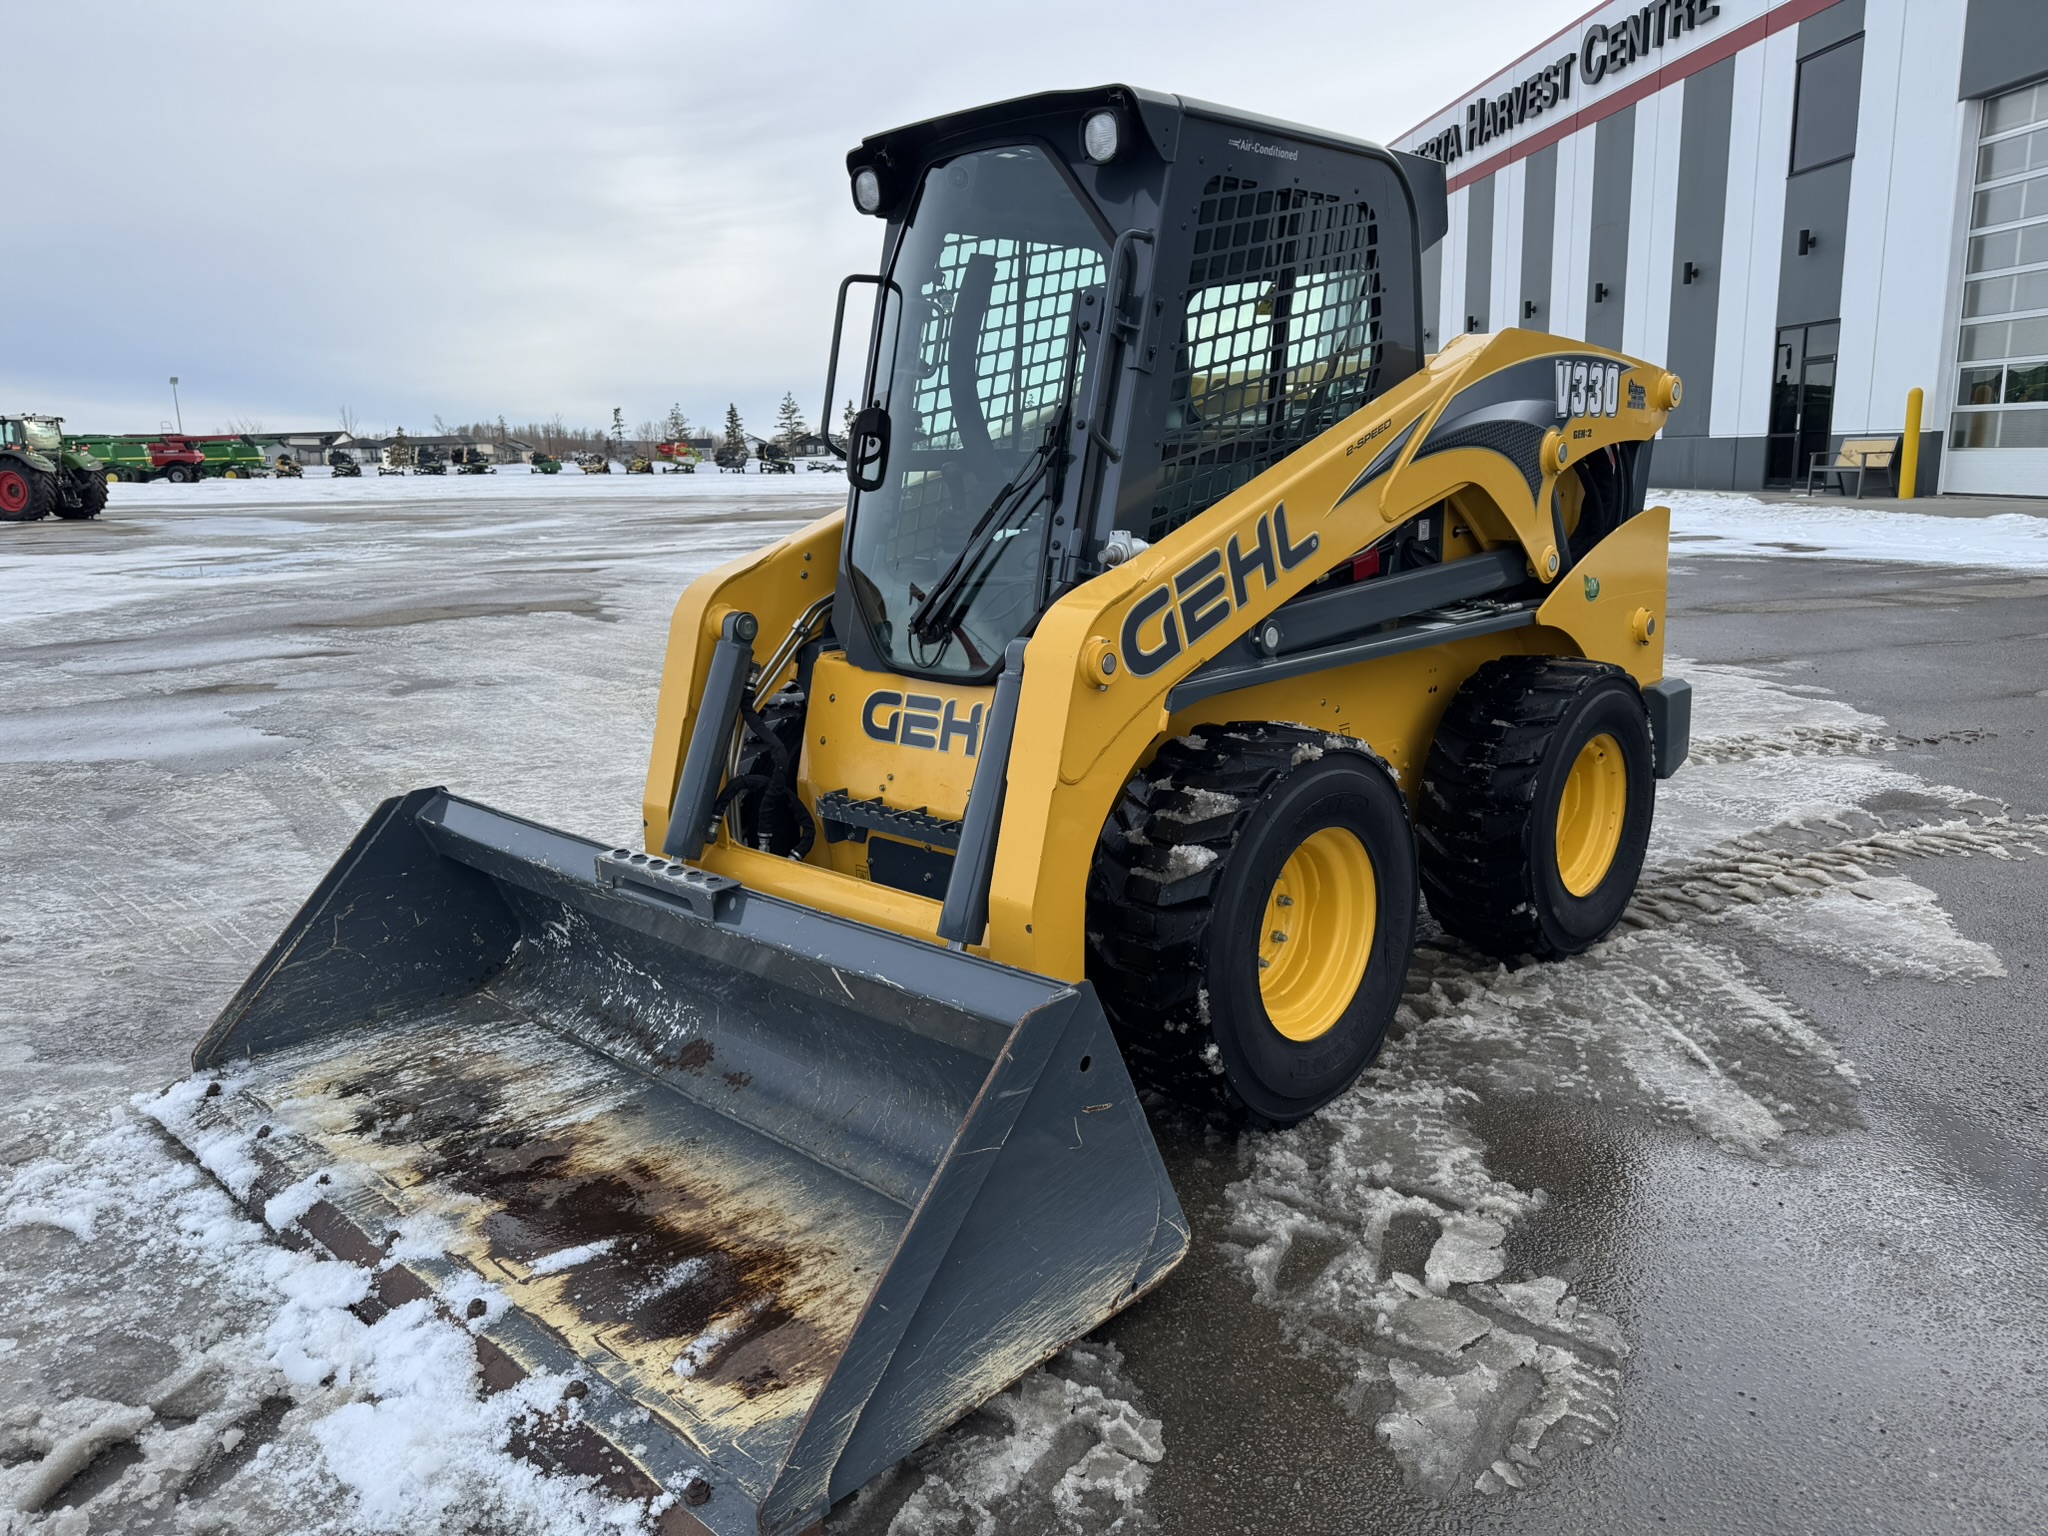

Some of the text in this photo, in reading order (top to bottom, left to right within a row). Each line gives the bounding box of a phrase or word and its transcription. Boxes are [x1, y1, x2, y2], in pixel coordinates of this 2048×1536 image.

[1465, 53, 1576, 152] HARVEST
[1240, 139, 1299, 161] Air-Conditioned
[1555, 359, 1620, 418] V330
[1346, 418, 1392, 457] 2-SPEED
[1119, 499, 1319, 678] GEHL
[861, 688, 991, 757] GEH
